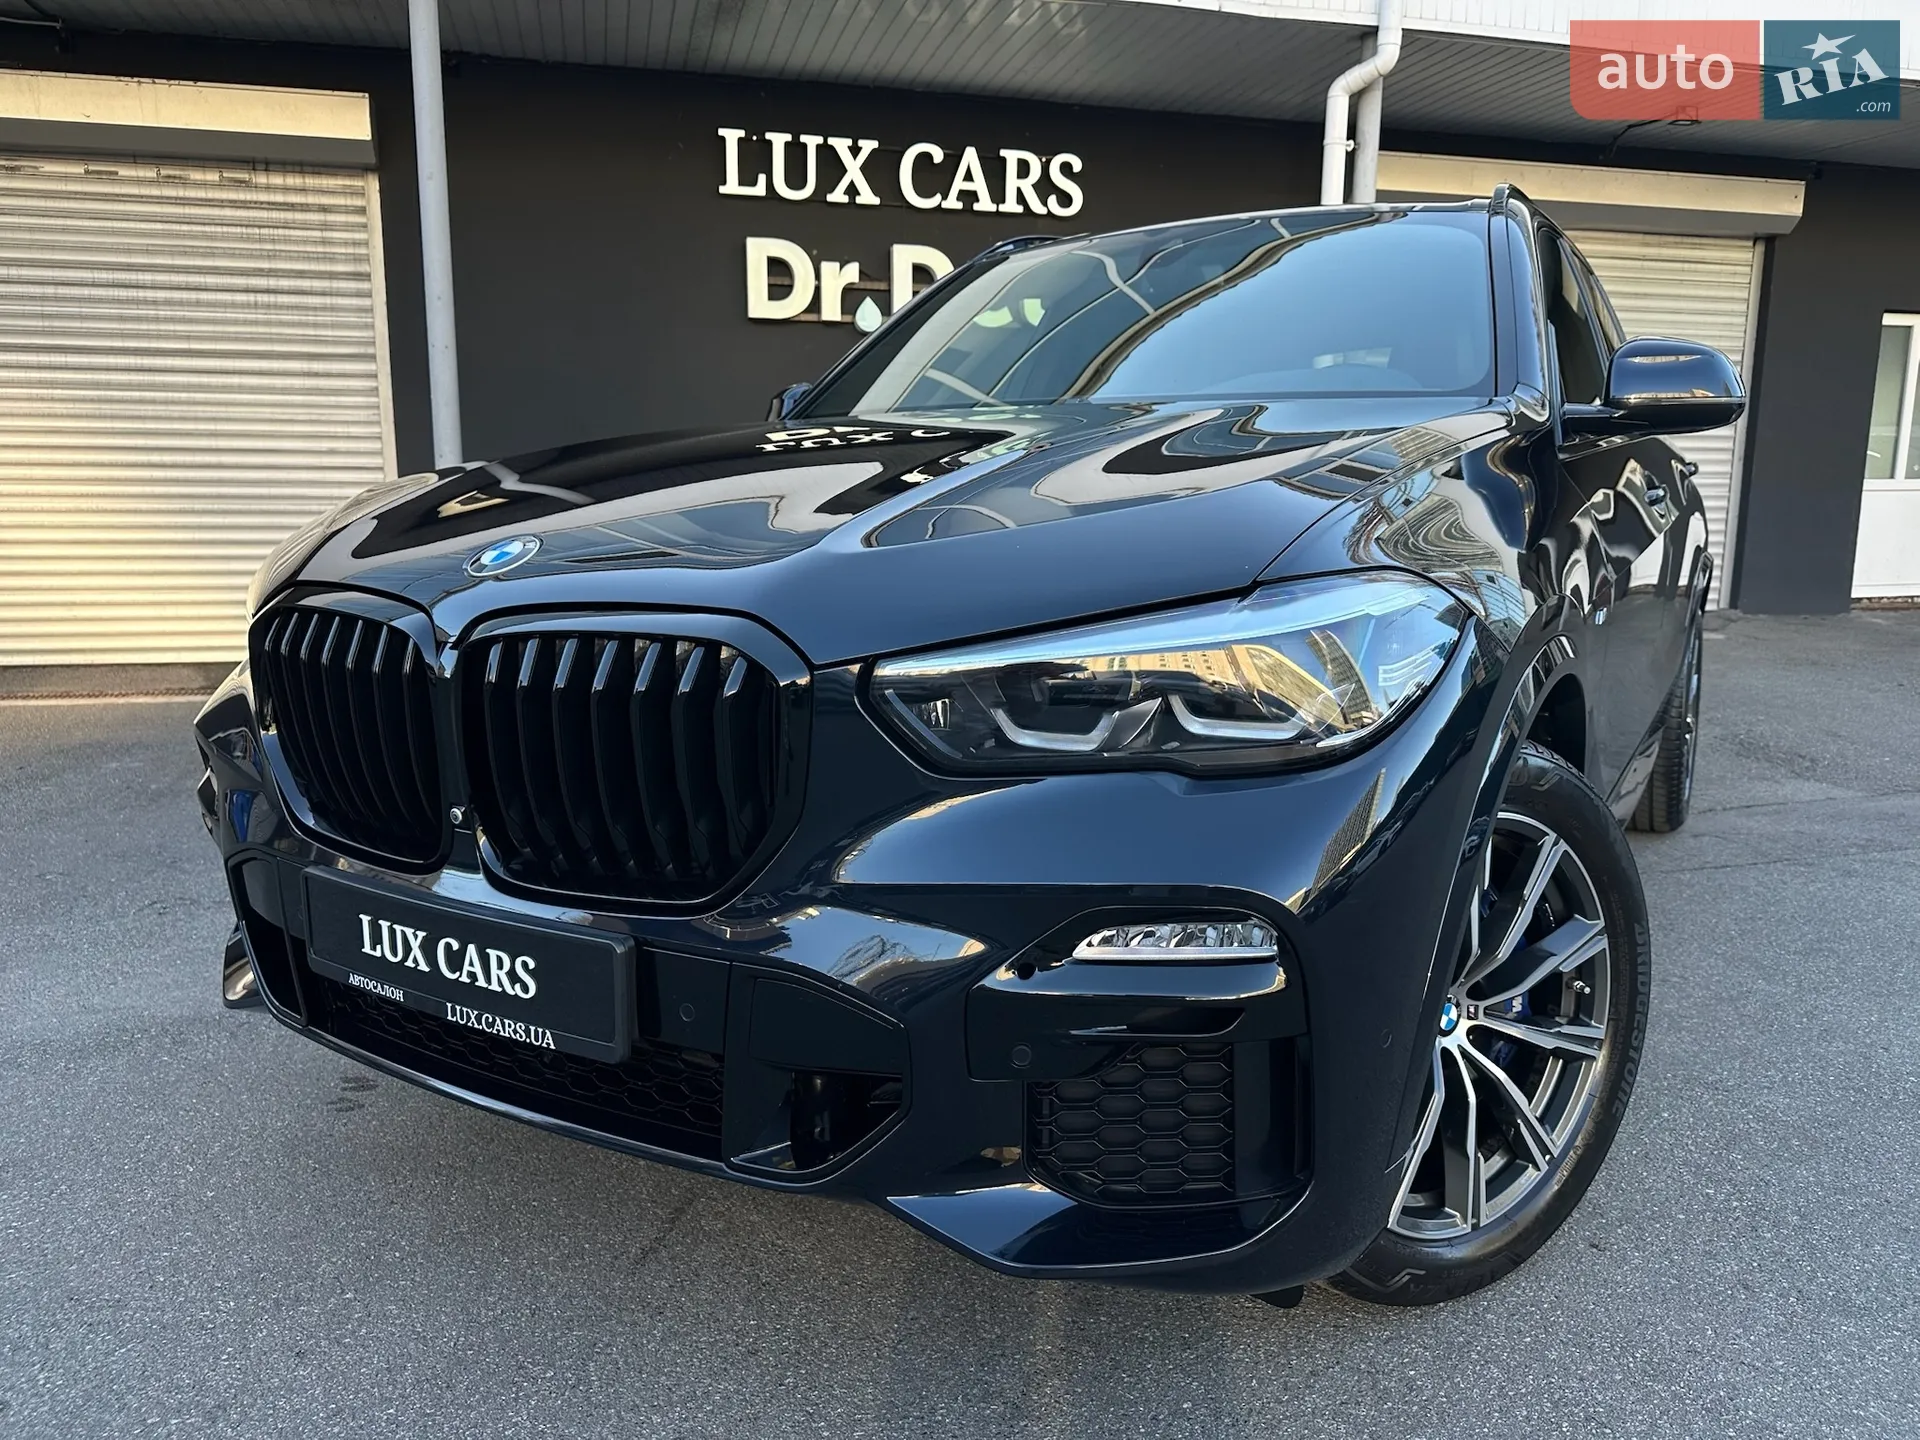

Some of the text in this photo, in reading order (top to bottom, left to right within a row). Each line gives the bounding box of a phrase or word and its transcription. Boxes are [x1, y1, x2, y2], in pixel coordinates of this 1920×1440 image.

[717, 127, 1084, 218] LUX CARS
[348, 972, 405, 1002] АВТОСАЛОН
[358, 913, 538, 1000] LUX CARS
[446, 1002, 556, 1050] LUX.CARS.UA
[1611, 921, 1651, 1119] BRIDGESTONE
